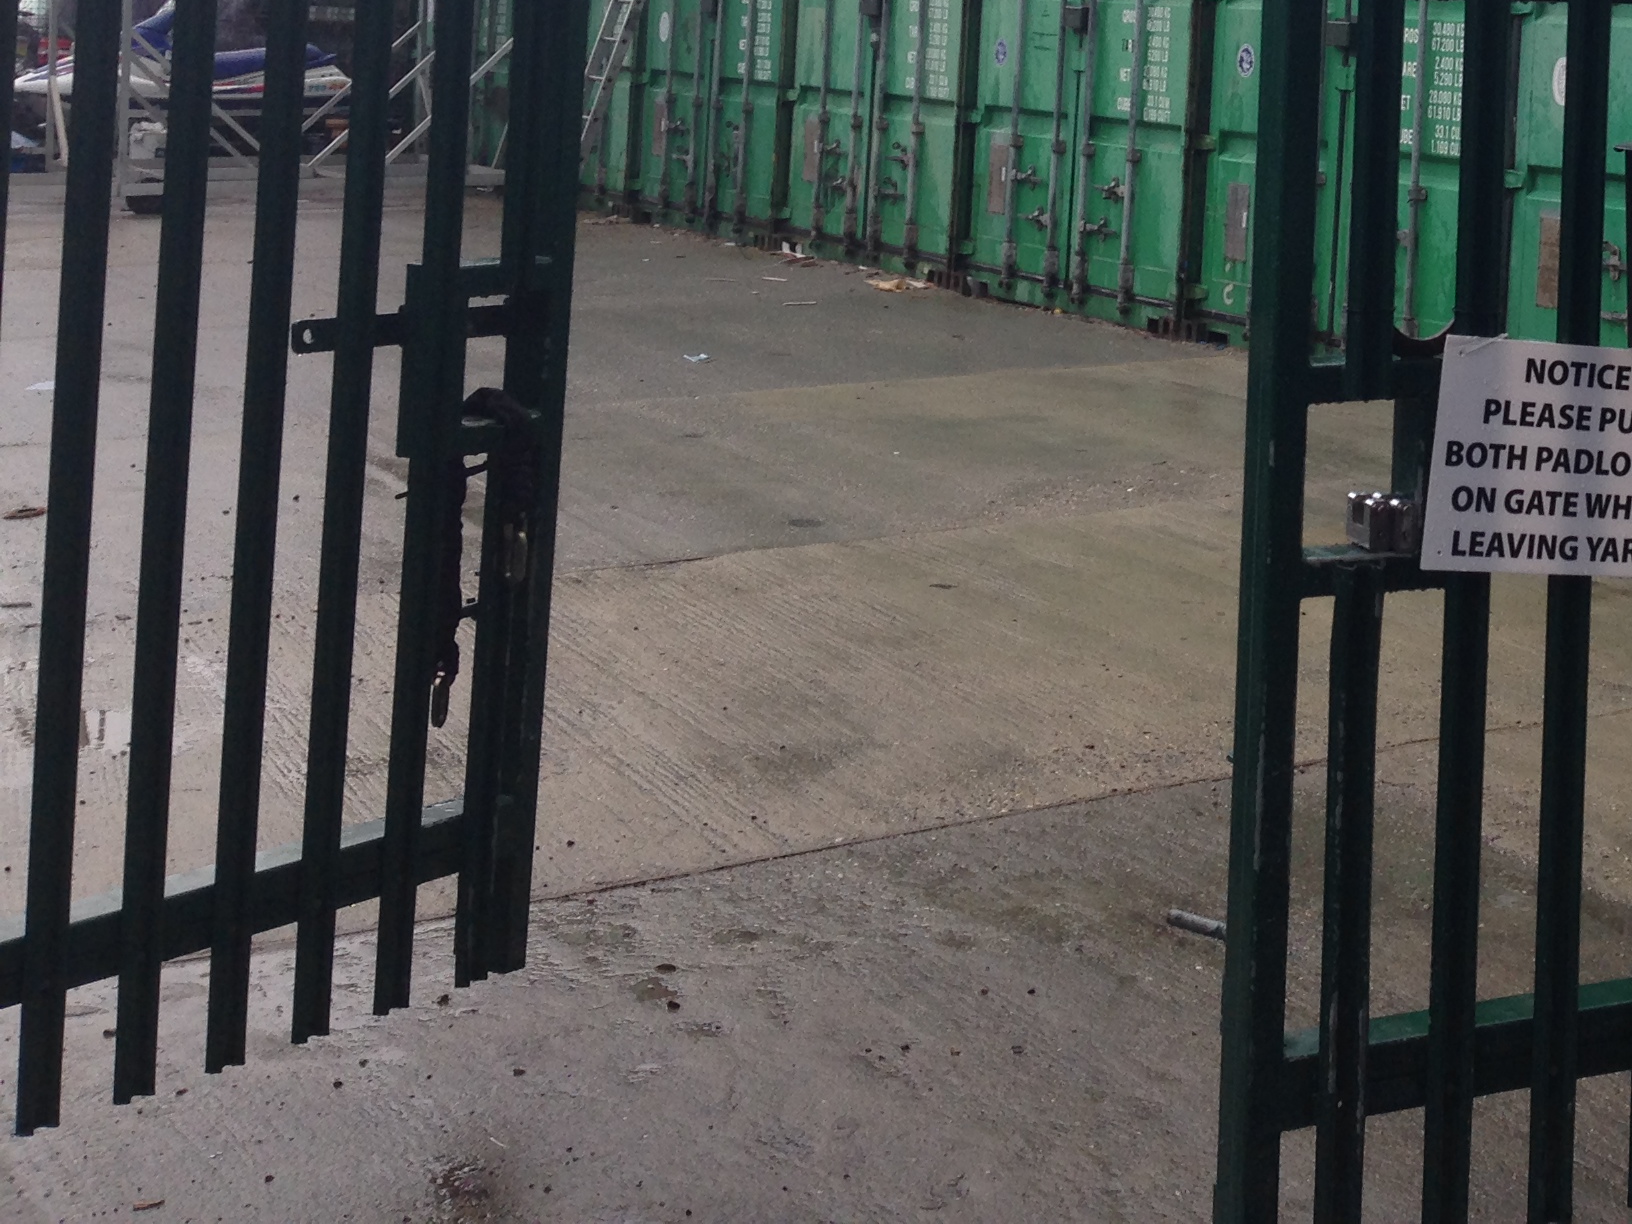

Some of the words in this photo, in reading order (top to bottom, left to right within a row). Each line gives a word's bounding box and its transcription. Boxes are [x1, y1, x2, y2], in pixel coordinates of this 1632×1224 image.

[1402, 61, 1418, 78] ARE
[1400, 94, 1411, 110] ET
[1524, 357, 1632, 392] NOTICE
[1482, 398, 1592, 432] PLEASE
[1444, 440, 1528, 471] BOTH
[1450, 485, 1497, 513] ON
[1503, 488, 1579, 518] GATE
[1450, 530, 1579, 561] LEAVING
